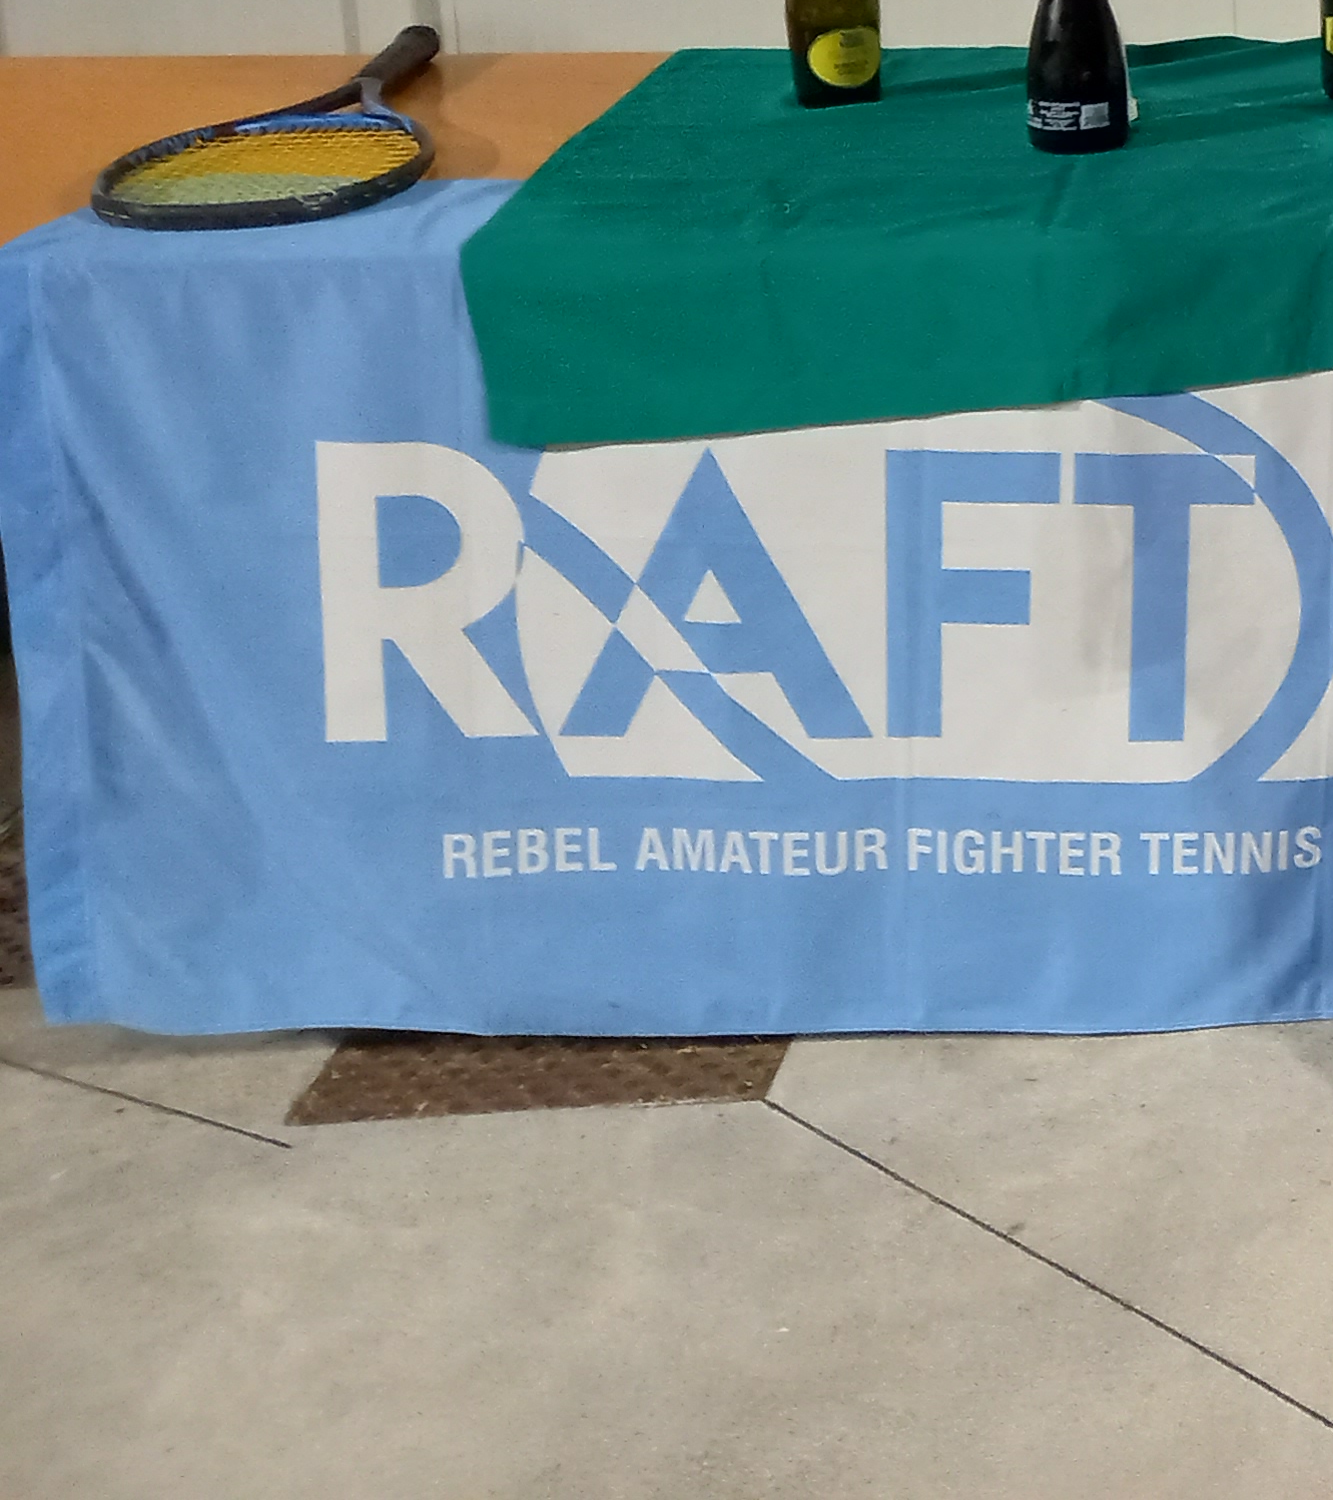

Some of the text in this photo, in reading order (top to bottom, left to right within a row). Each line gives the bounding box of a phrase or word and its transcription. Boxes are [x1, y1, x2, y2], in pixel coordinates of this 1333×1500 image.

[315, 440, 1256, 744] RAFT
[441, 825, 1323, 879] REBEL AMATEUR FIGHTER TENNIS
